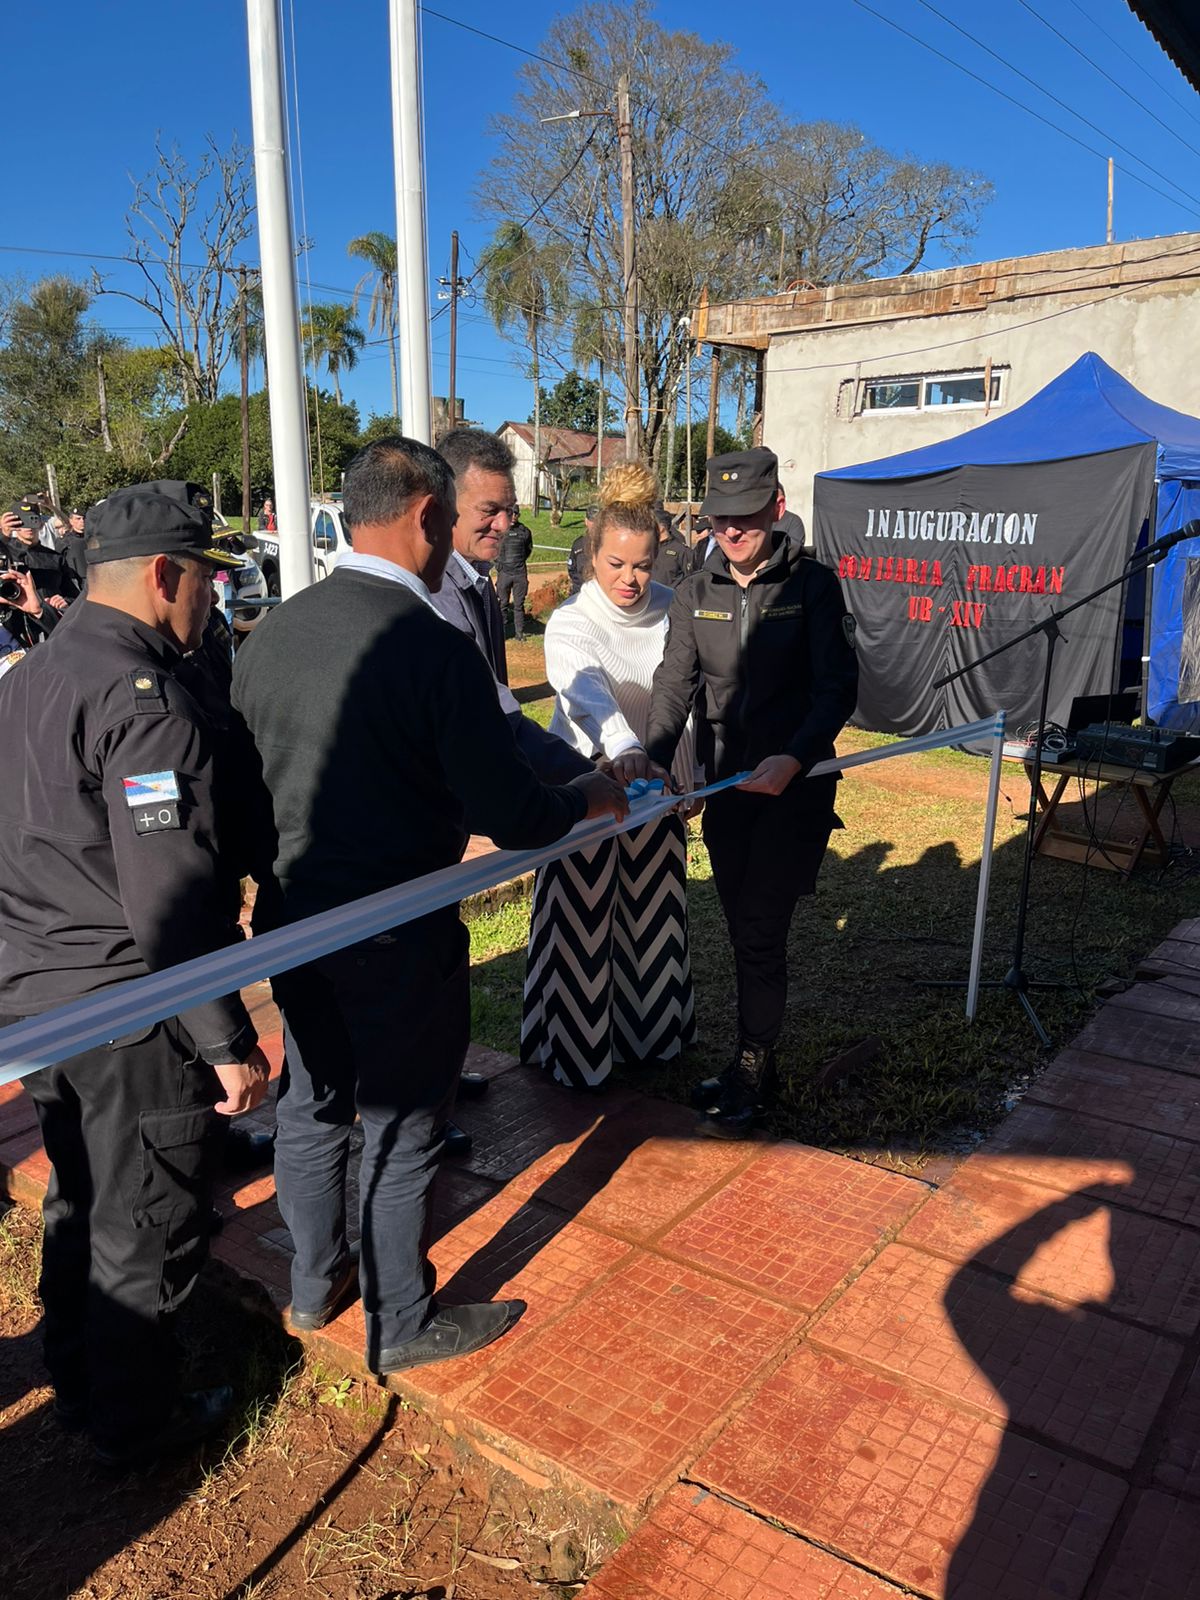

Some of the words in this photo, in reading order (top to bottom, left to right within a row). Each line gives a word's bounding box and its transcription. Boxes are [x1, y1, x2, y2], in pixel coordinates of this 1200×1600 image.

[865, 509, 1038, 545] INAUGURACION
[838, 554, 943, 586] COMISARIA
[966, 564, 1064, 595] FRACRAN
[950, 600, 986, 628] XIV
